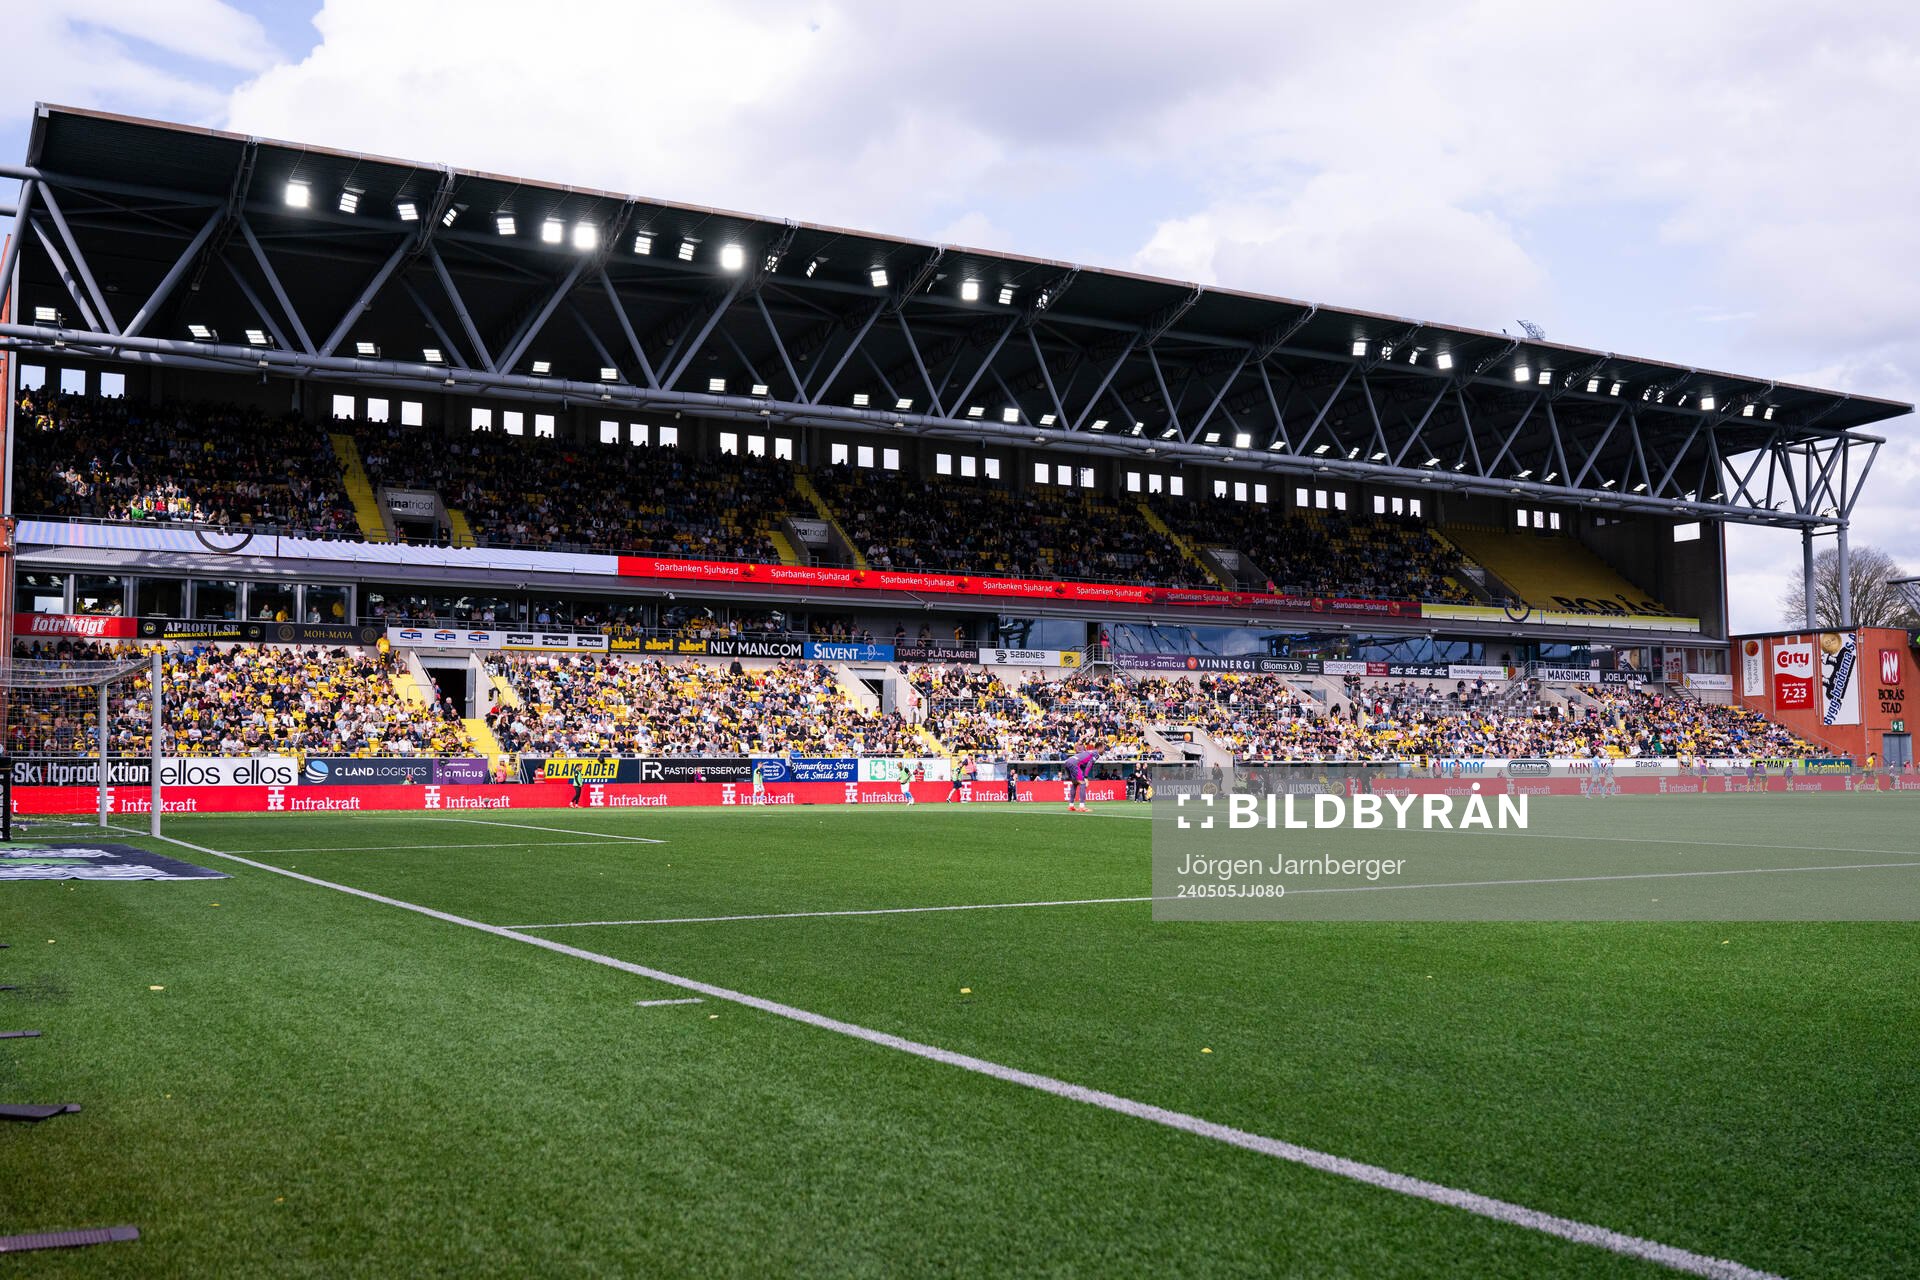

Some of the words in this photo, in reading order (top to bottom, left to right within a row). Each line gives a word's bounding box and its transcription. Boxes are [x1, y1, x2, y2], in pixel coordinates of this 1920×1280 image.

[654, 562, 702, 573] Sparbanken
[704, 565, 738, 576] Sjuhärad
[771, 569, 815, 580] Sparbanken
[818, 571, 850, 582] Sjuhärad
[880, 575, 923, 586] Sparbanken
[924, 577, 954, 587] Sjuhärad
[983, 581, 1023, 591] Sparbanken
[1076, 586, 1113, 596] Sparbanken
[32, 616, 105, 635] fotriktigt
[303, 630, 353, 639] MOH-MAYA
[511, 636, 533, 644] Parker
[547, 637, 568, 645] Parker
[582, 638, 603, 646] Parker
[711, 641, 735, 654] NLY
[738, 643, 801, 656] MAN.COM
[897, 648, 926, 657] TOARPS
[928, 648, 977, 659] PLÅTSLAGERI
[1120, 659, 1149, 667] amicus
[1157, 660, 1186, 668] amicus
[1199, 659, 1256, 669] VINNERGI
[1777, 650, 1809, 668] City
[1288, 662, 1300, 670] AB
[1389, 665, 1403, 675] stc
[1405, 665, 1418, 675] stc
[1420, 666, 1433, 676] stc
[1434, 667, 1448, 676] stc
[1547, 670, 1590, 680] MAKSIMER
[1782, 688, 1807, 699] 7-23
[1878, 687, 1905, 701] BORÅS
[1881, 702, 1902, 714] STAD
[791, 761, 829, 772] Sjömarkens
[834, 761, 854, 771] Svets
[1635, 760, 1663, 768] Stadax
[1808, 762, 1850, 774] Asemblin
[14, 762, 149, 786] Skyltprodktion
[160, 760, 220, 785] ellos
[233, 760, 292, 785] ellos
[335, 767, 343, 776] C
[345, 767, 374, 776] LAND
[376, 767, 427, 776] LOGISTICS
[444, 769, 484, 778] amicus
[642, 762, 664, 780] FR
[665, 766, 750, 776] FASTIGHETSSERVICE
[796, 770, 809, 779] och
[811, 771, 834, 780] Smide
[835, 771, 849, 780] AB
[1156, 784, 1200, 796] ALLSVENSKAN
[1517, 785, 1551, 795] Infrakraft
[446, 796, 510, 809] Infrakraft
[609, 794, 668, 806] Infrakraft
[862, 791, 908, 803] Infrakra
[121, 798, 197, 813] Infrkraft
[291, 797, 361, 810] Infrakraft
